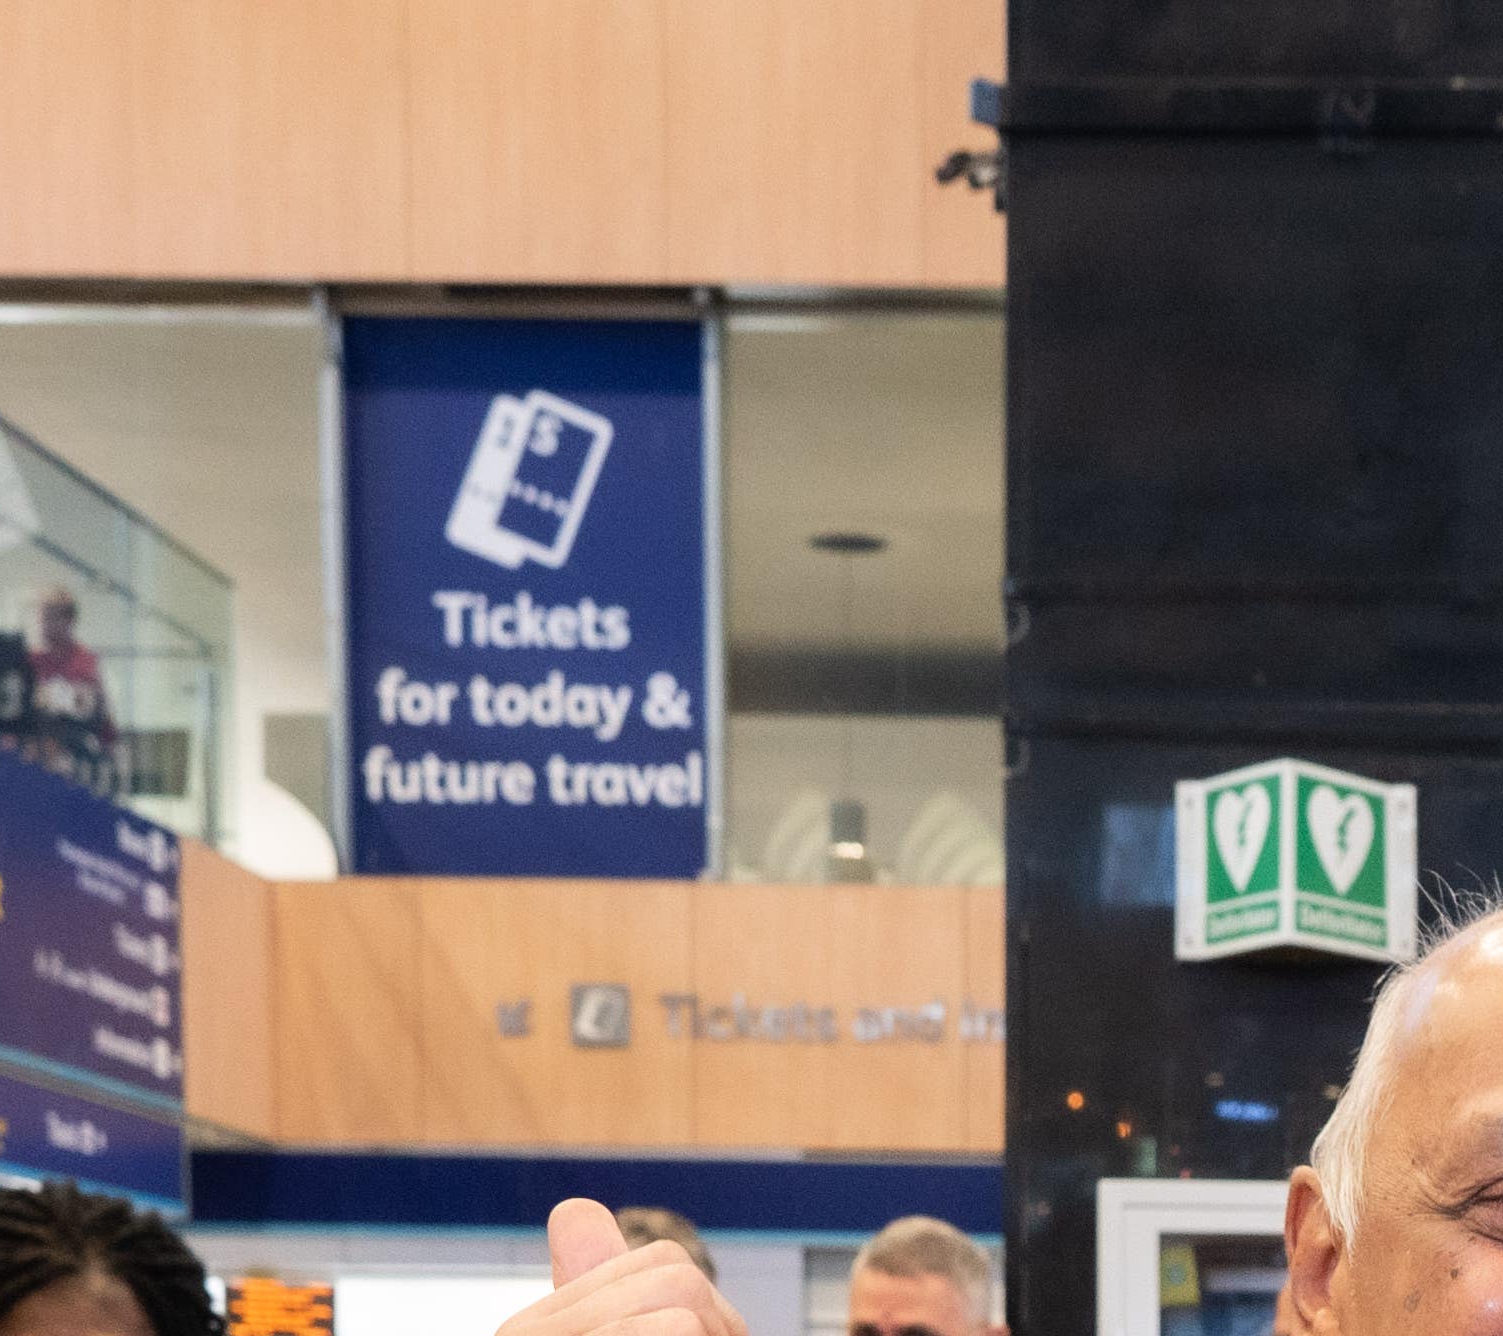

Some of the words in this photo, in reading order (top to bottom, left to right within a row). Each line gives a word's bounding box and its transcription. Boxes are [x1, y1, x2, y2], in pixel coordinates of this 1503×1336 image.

[432, 590, 631, 651] Tickets
[375, 666, 459, 726] for
[468, 670, 633, 742] today
[642, 671, 693, 730] &
[362, 746, 536, 806] future
[546, 752, 703, 808] travel
[658, 990, 838, 1043] Tickets
[852, 1001, 946, 1042] and
